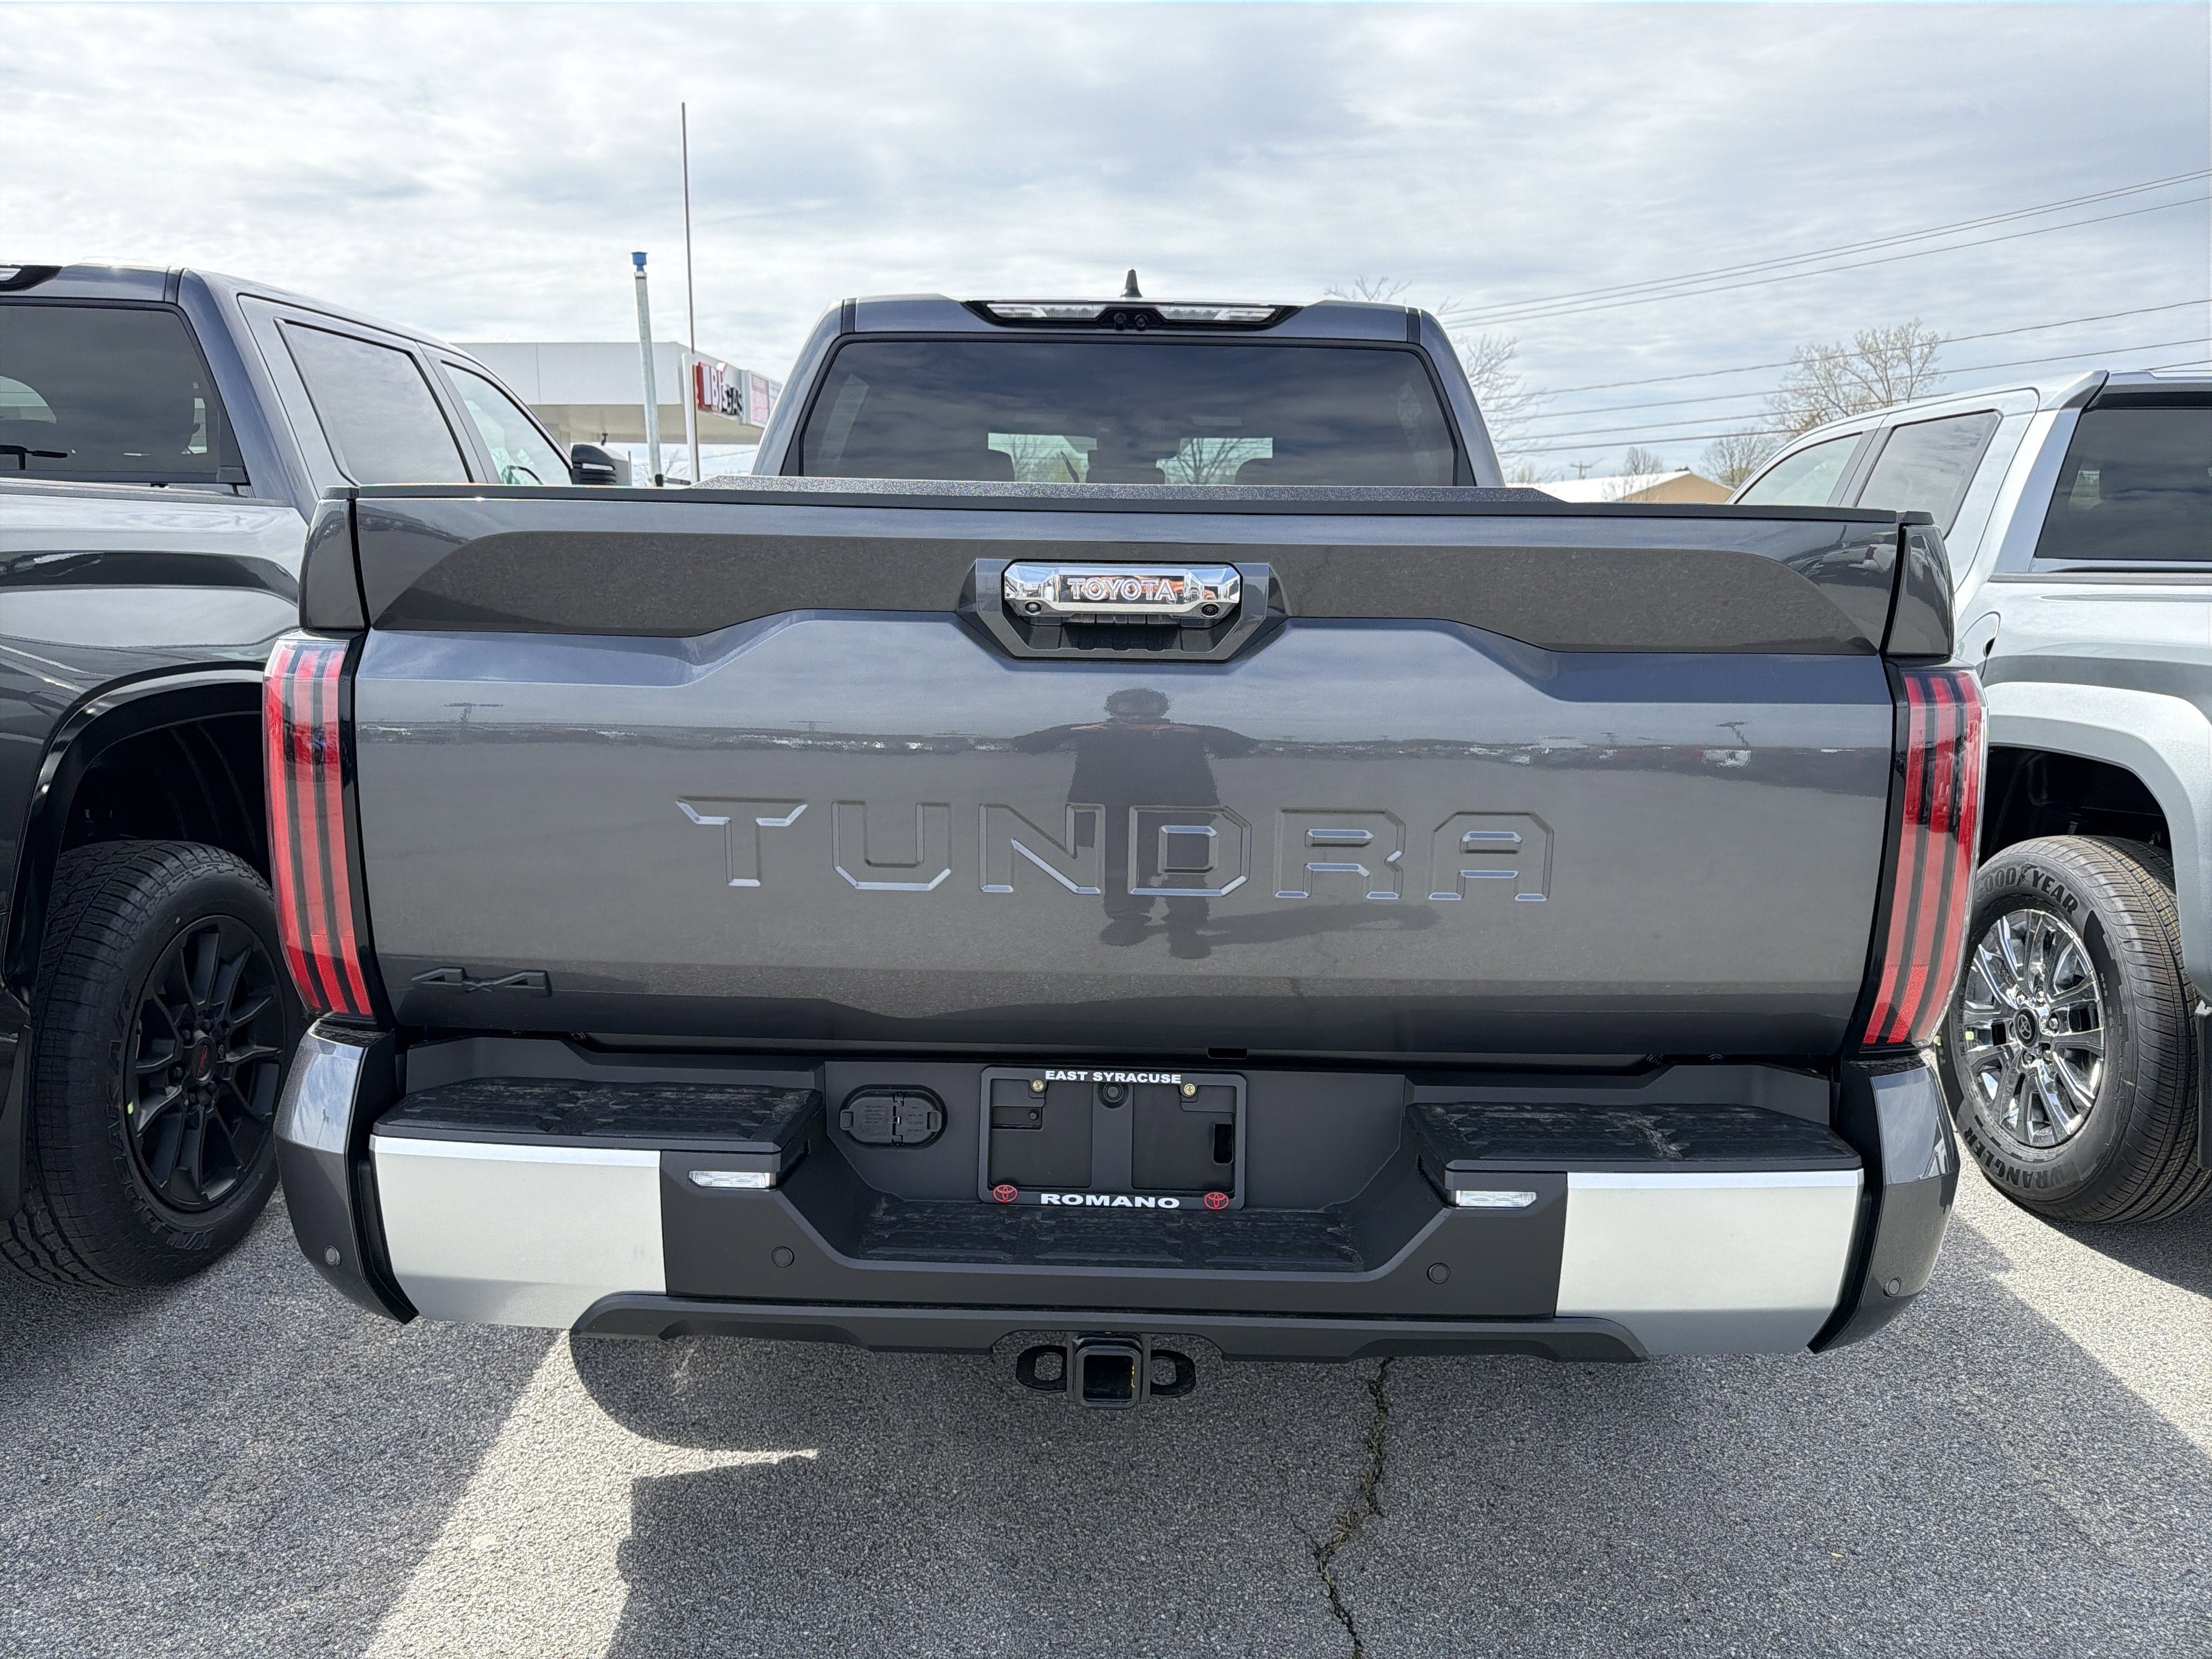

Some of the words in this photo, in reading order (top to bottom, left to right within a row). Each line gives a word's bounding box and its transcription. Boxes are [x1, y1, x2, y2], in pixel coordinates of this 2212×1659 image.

[1066, 577, 1177, 601] TOYOTA
[676, 795, 1554, 901] TUNDRA
[1045, 1070, 1088, 1081] EAST
[1093, 1071, 1182, 1084] SYRACUSE
[1963, 1126, 2066, 1189] WRANGLER
[1041, 1193, 1180, 1209] ROMANO
